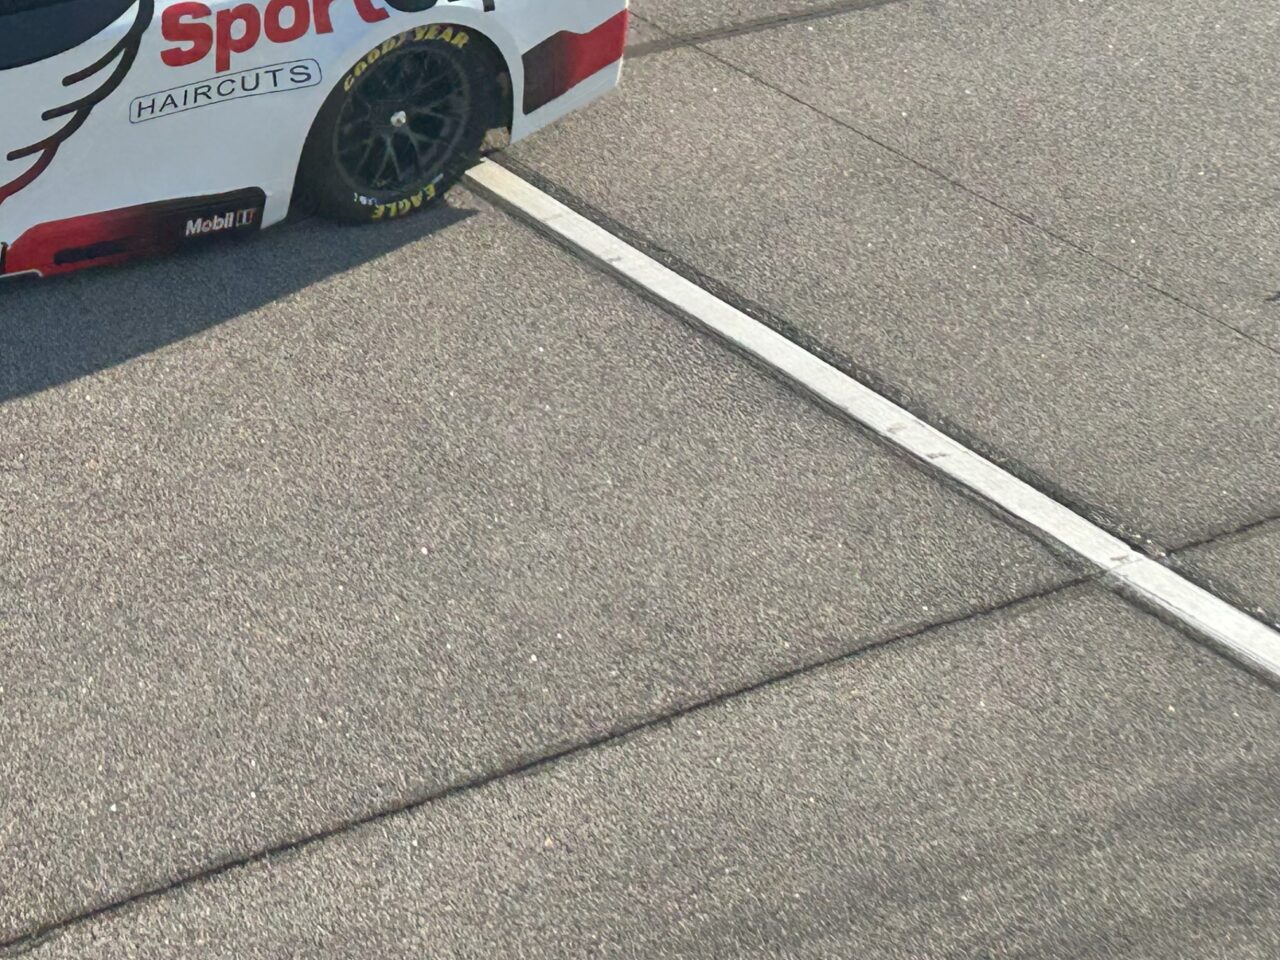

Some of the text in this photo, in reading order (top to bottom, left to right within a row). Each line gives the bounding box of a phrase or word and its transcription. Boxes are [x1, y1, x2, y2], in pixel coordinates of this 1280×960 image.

[343, 24, 470, 92] GOODYEAR
[136, 63, 313, 120] HAIRCUTS
[185, 211, 235, 237] Mobil
[371, 183, 437, 220] EAGLE
